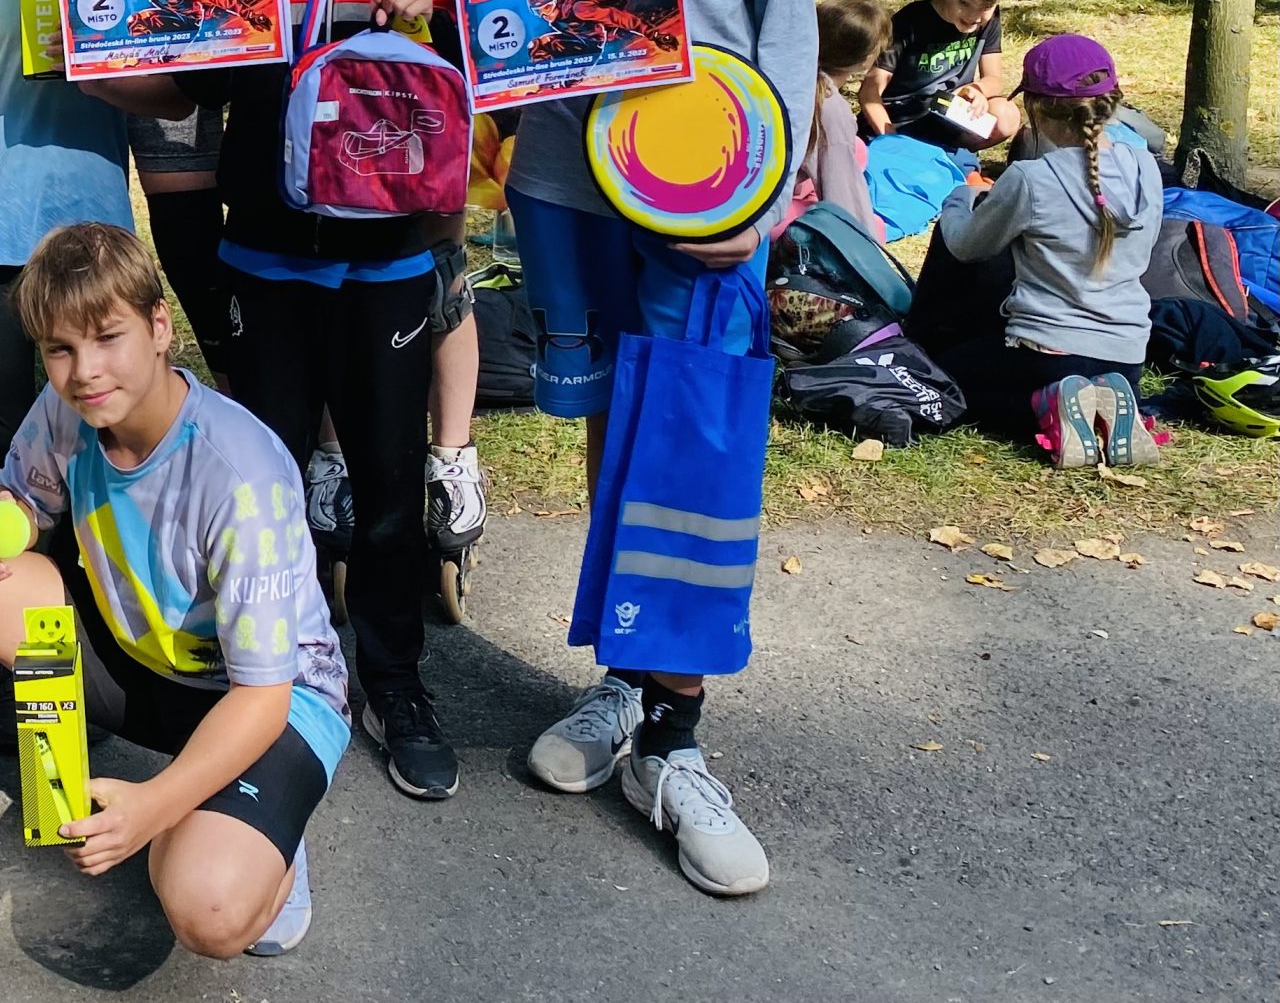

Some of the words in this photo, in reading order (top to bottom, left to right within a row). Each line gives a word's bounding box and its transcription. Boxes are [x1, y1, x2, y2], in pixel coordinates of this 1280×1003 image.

[88, 12, 118, 24] MÍSTO
[492, 16, 514, 38] 2.
[80, 39, 124, 50] Středočeská
[148, 34, 170, 42] brusle
[172, 32, 190, 40] 2023
[488, 40, 518, 52] MÍSTO
[482, 66, 525, 80] Středočeská
[550, 59, 572, 68] brusle
[574, 56, 594, 64] 2023
[384, 90, 419, 100] KIPSTA
[26, 702, 38, 710] TB
[39, 702, 54, 710] 160
[62, 702, 74, 710] X3
